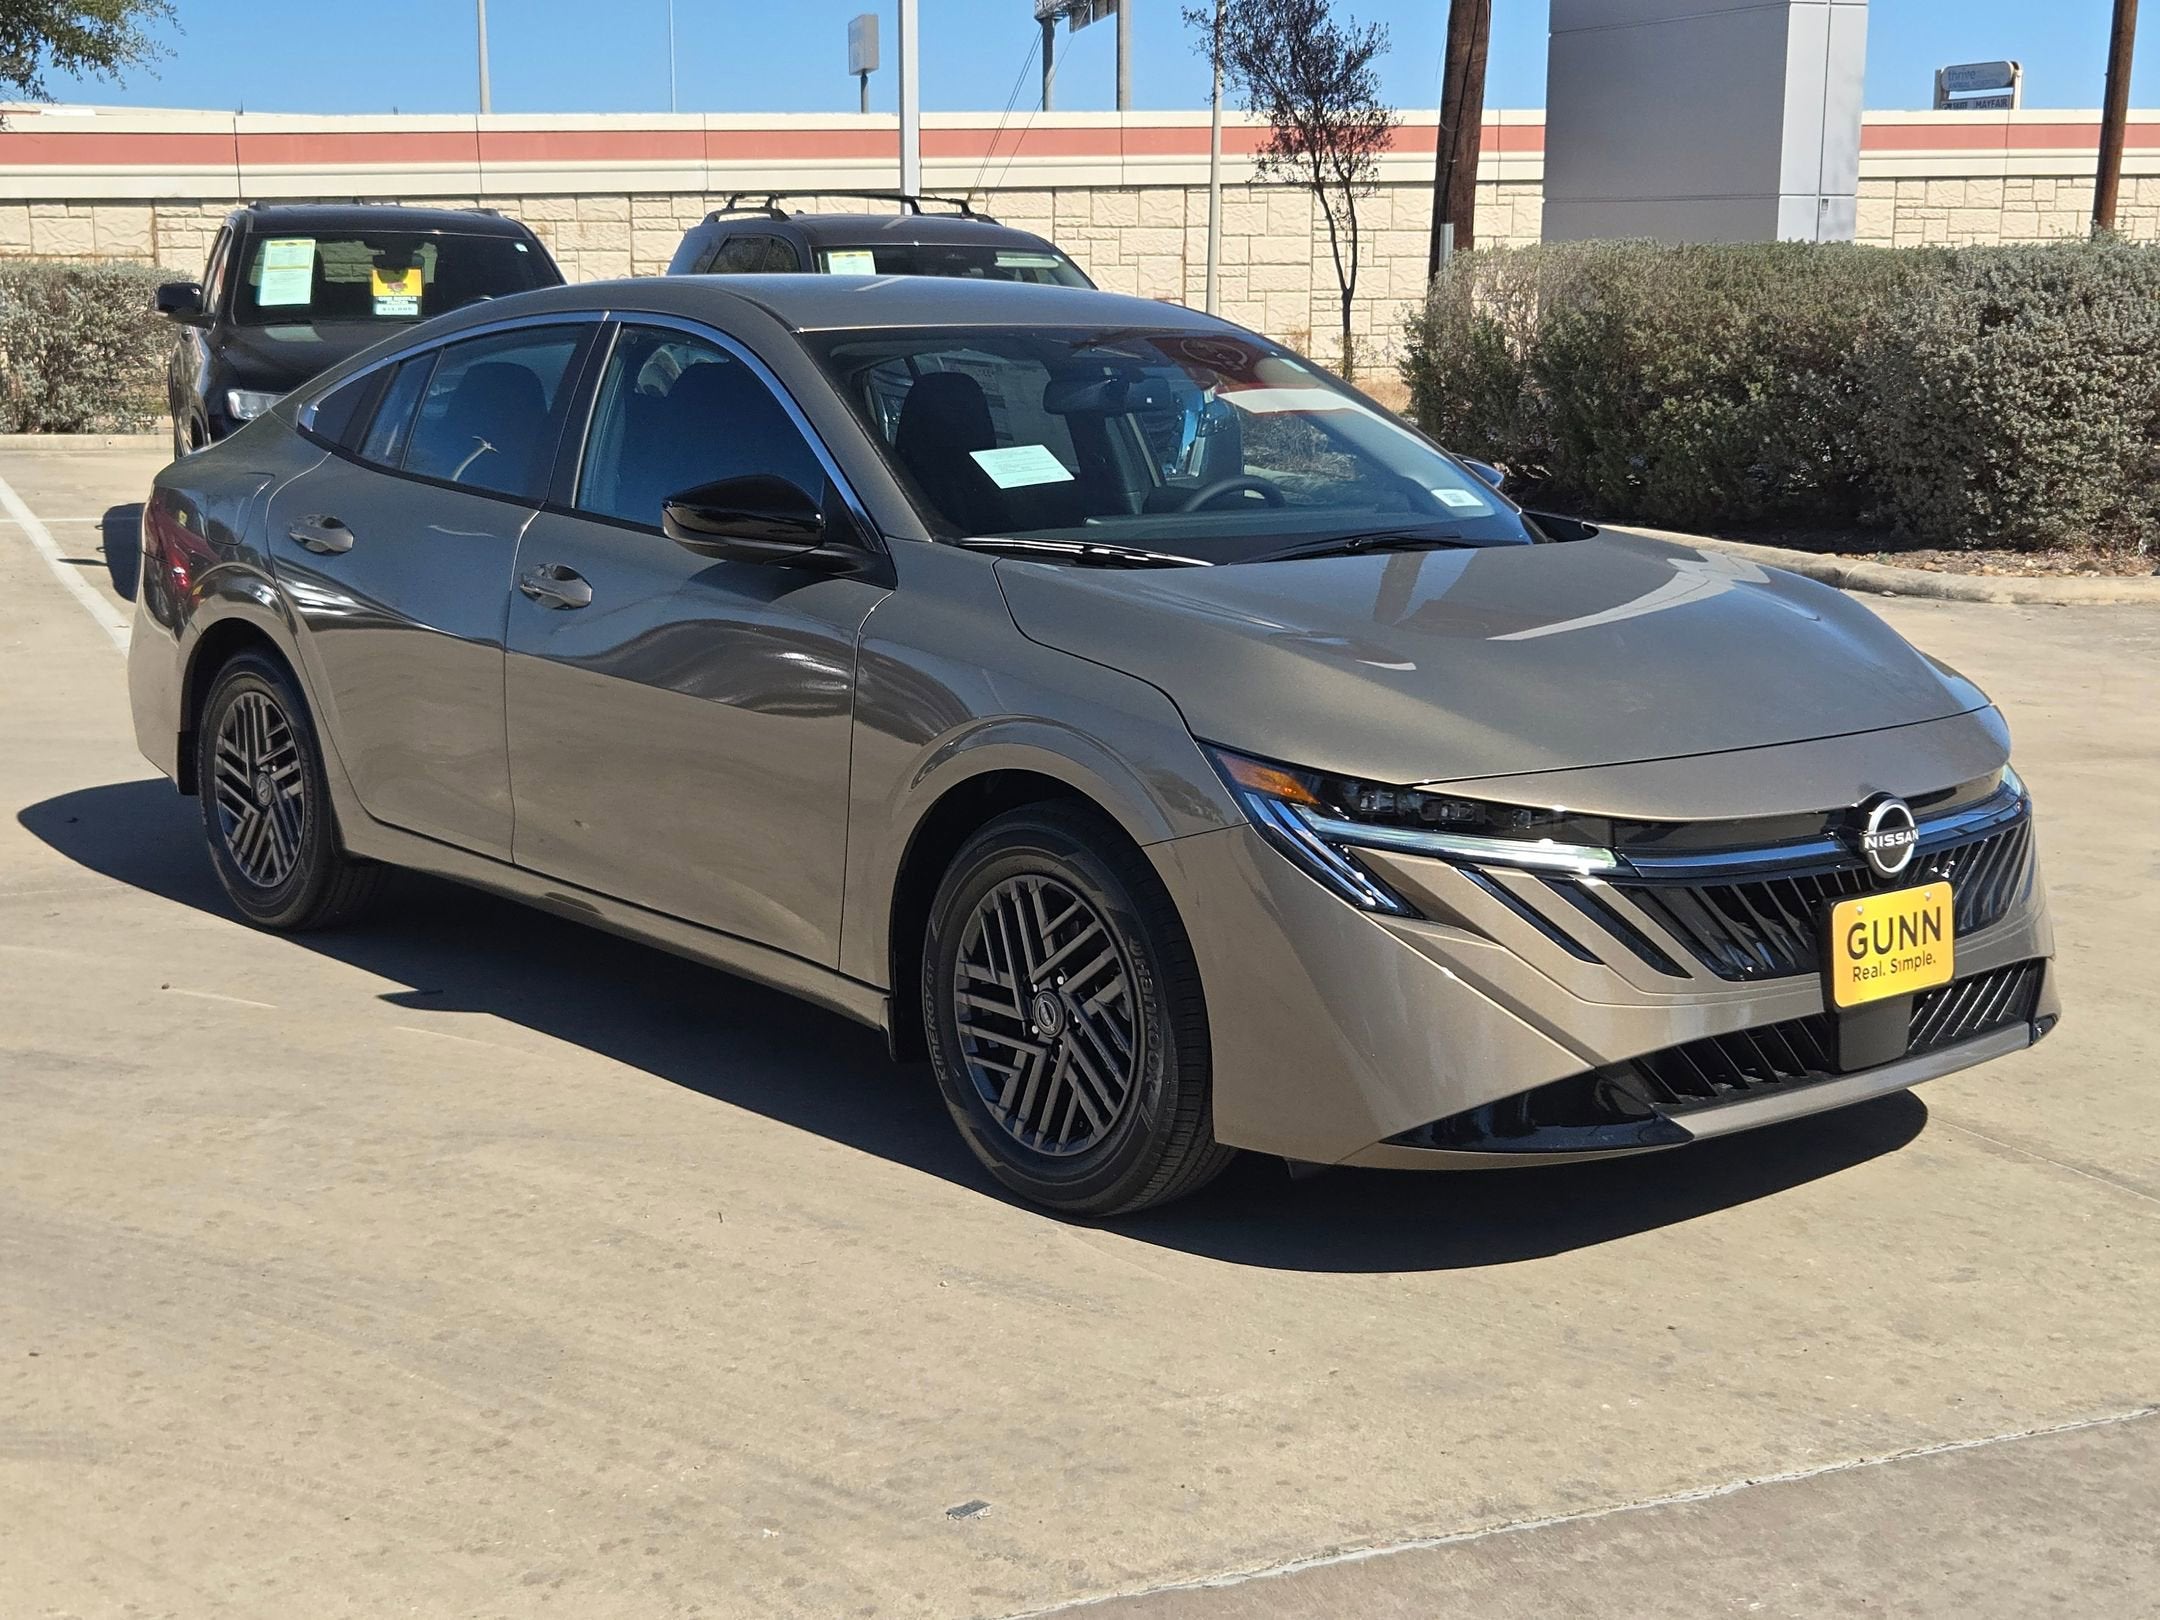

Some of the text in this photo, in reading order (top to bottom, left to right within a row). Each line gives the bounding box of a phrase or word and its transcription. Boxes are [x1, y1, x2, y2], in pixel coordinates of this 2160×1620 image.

[1975, 98, 2008, 109] MAYFAIR
[1864, 828, 1919, 850] NISSAN
[1847, 906, 1942, 960] GUNN
[1852, 952, 1937, 983] Real. Simple.
